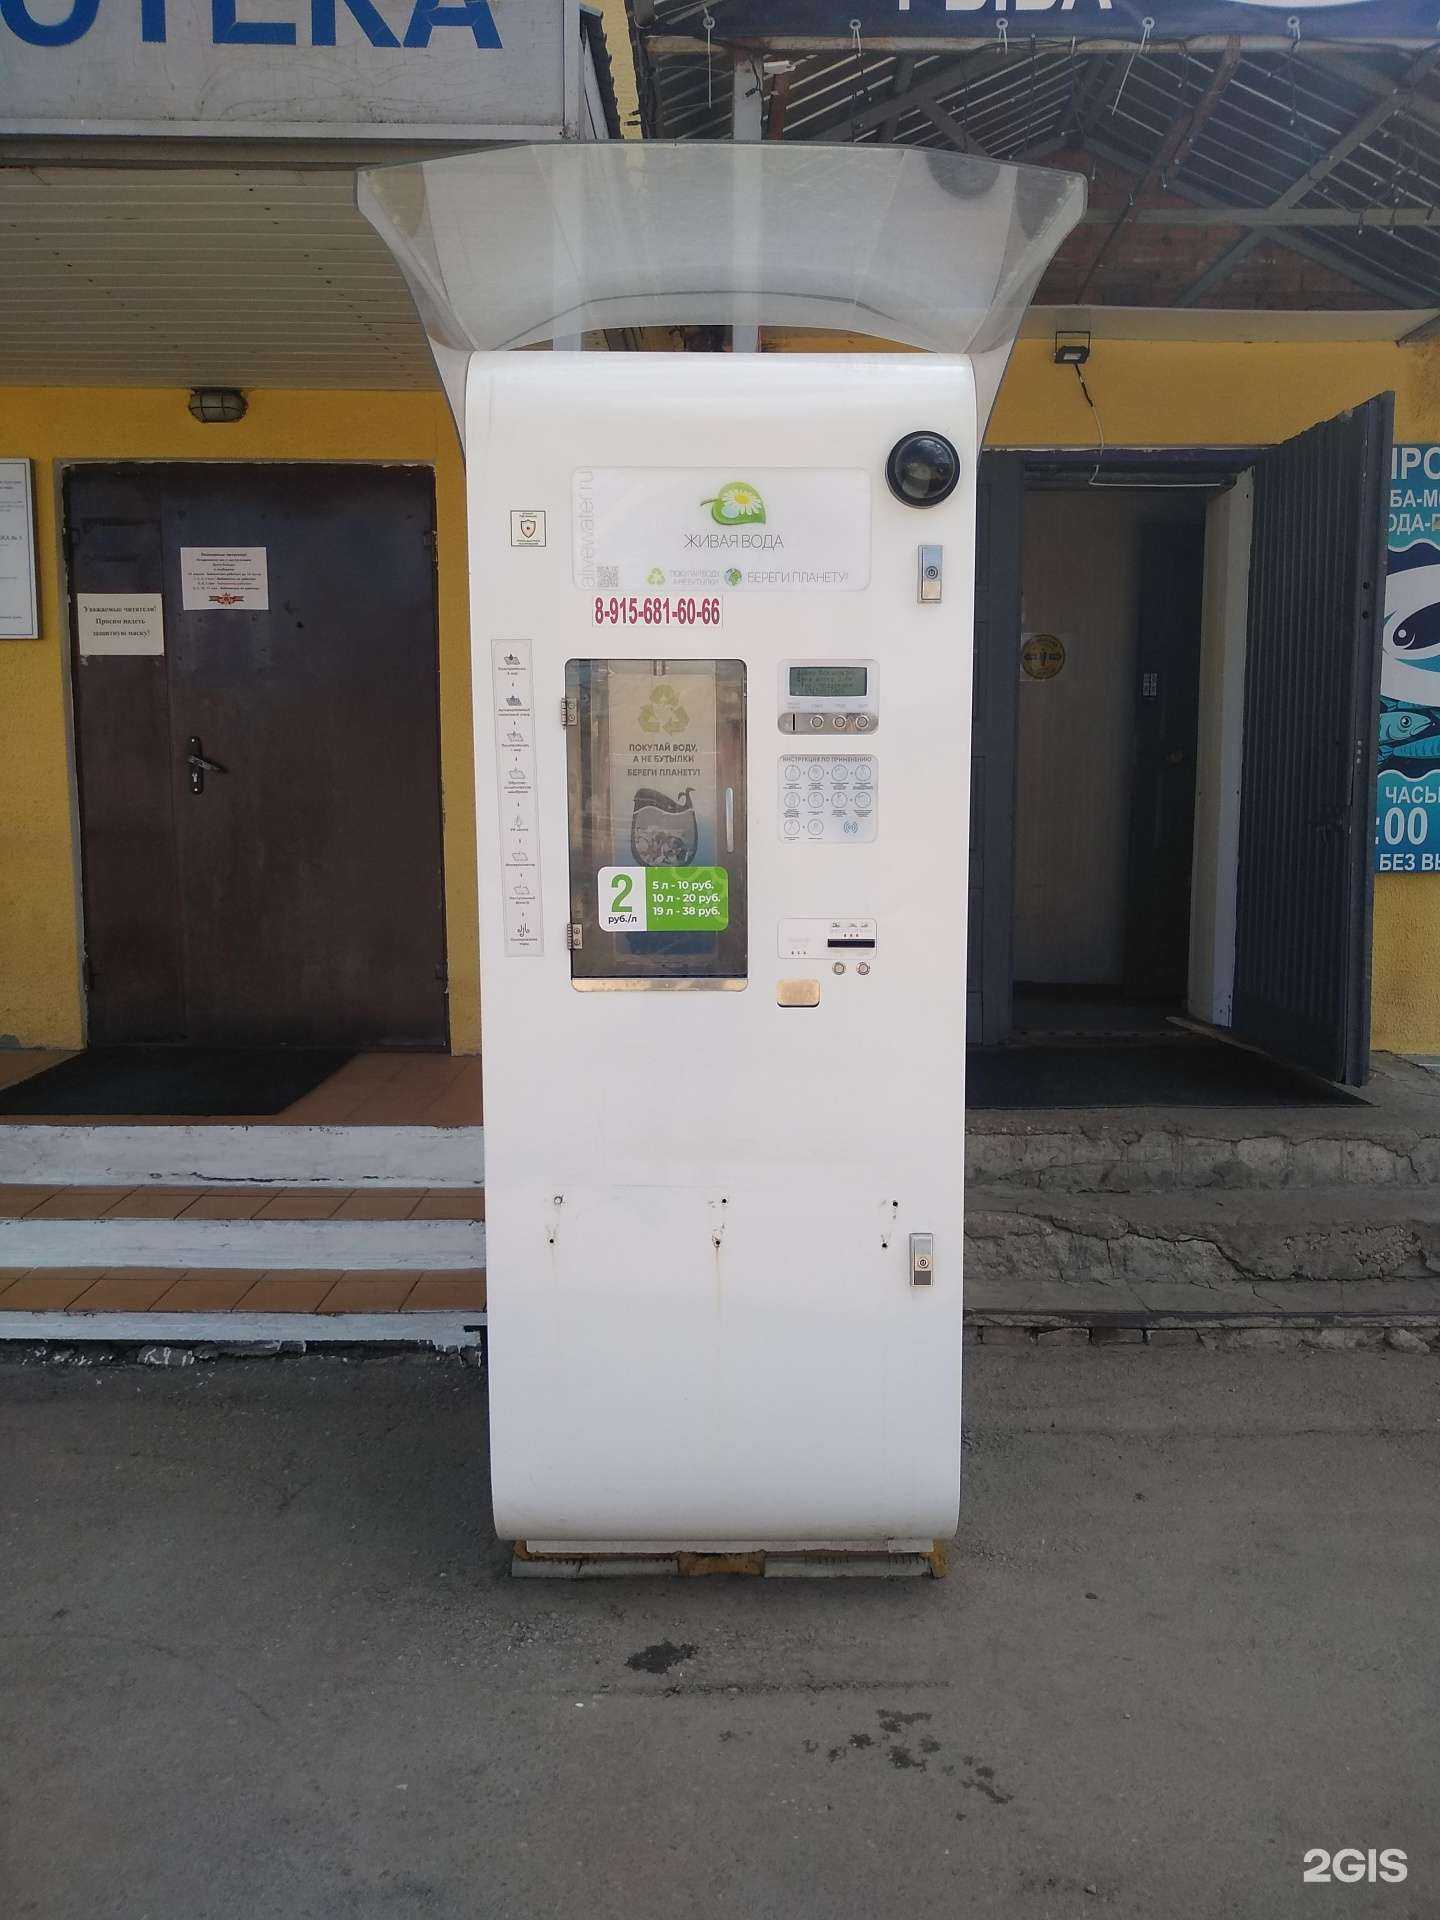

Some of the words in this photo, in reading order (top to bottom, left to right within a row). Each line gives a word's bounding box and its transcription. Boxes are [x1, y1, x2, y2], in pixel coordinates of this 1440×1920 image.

[684, 534, 739, 549] ЖИВАЯ
[741, 534, 785, 550] ВОДА
[747, 571, 791, 584] БЕРЕГИ
[792, 571, 849, 584] ПЛАНЕТУ!
[595, 597, 720, 624] 8-915-681-60-66
[629, 742, 671, 752] ПОКУПАЙ
[633, 755, 640, 763] А
[654, 755, 695, 763] БУТЫЛКИ
[627, 768, 657, 776] БЕРЕГИ
[1379, 853, 1416, 871] БЕЗ
[652, 881, 660, 890] 5
[678, 881, 689, 890] 10
[691, 880, 714, 891] руб.
[611, 874, 633, 912] 2
[652, 894, 664, 902] 10
[683, 894, 696, 902] 20
[698, 894, 720, 904] руб.
[652, 907, 664, 916] 19
[682, 907, 696, 916] 38
[698, 906, 720, 917] руб.
[608, 914, 637, 924] руб./л
